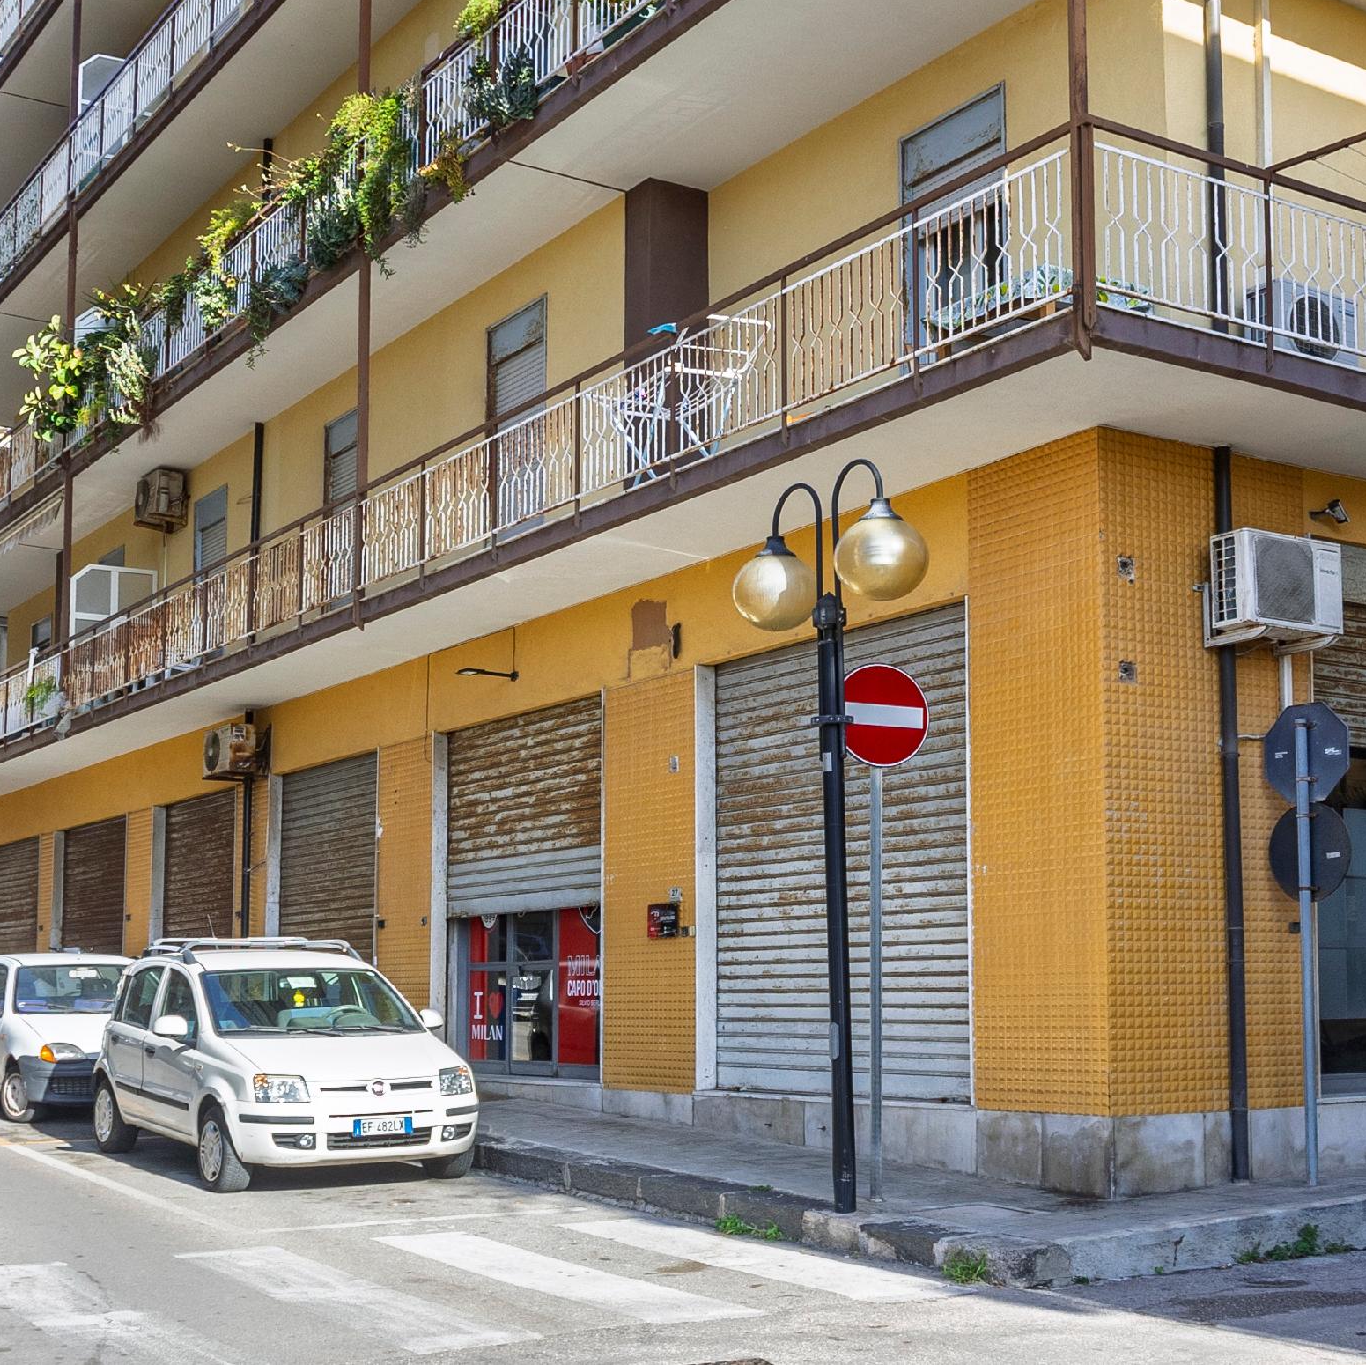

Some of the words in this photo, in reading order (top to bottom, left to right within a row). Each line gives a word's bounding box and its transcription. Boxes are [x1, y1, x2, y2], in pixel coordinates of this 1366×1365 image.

[567, 954, 601, 976] MILA
[567, 979, 586, 996] CAPO
[586, 979, 601, 996] D'O
[474, 991, 483, 1019] I
[471, 1024, 503, 1041] MILAN
[362, 1121, 373, 1133] EF
